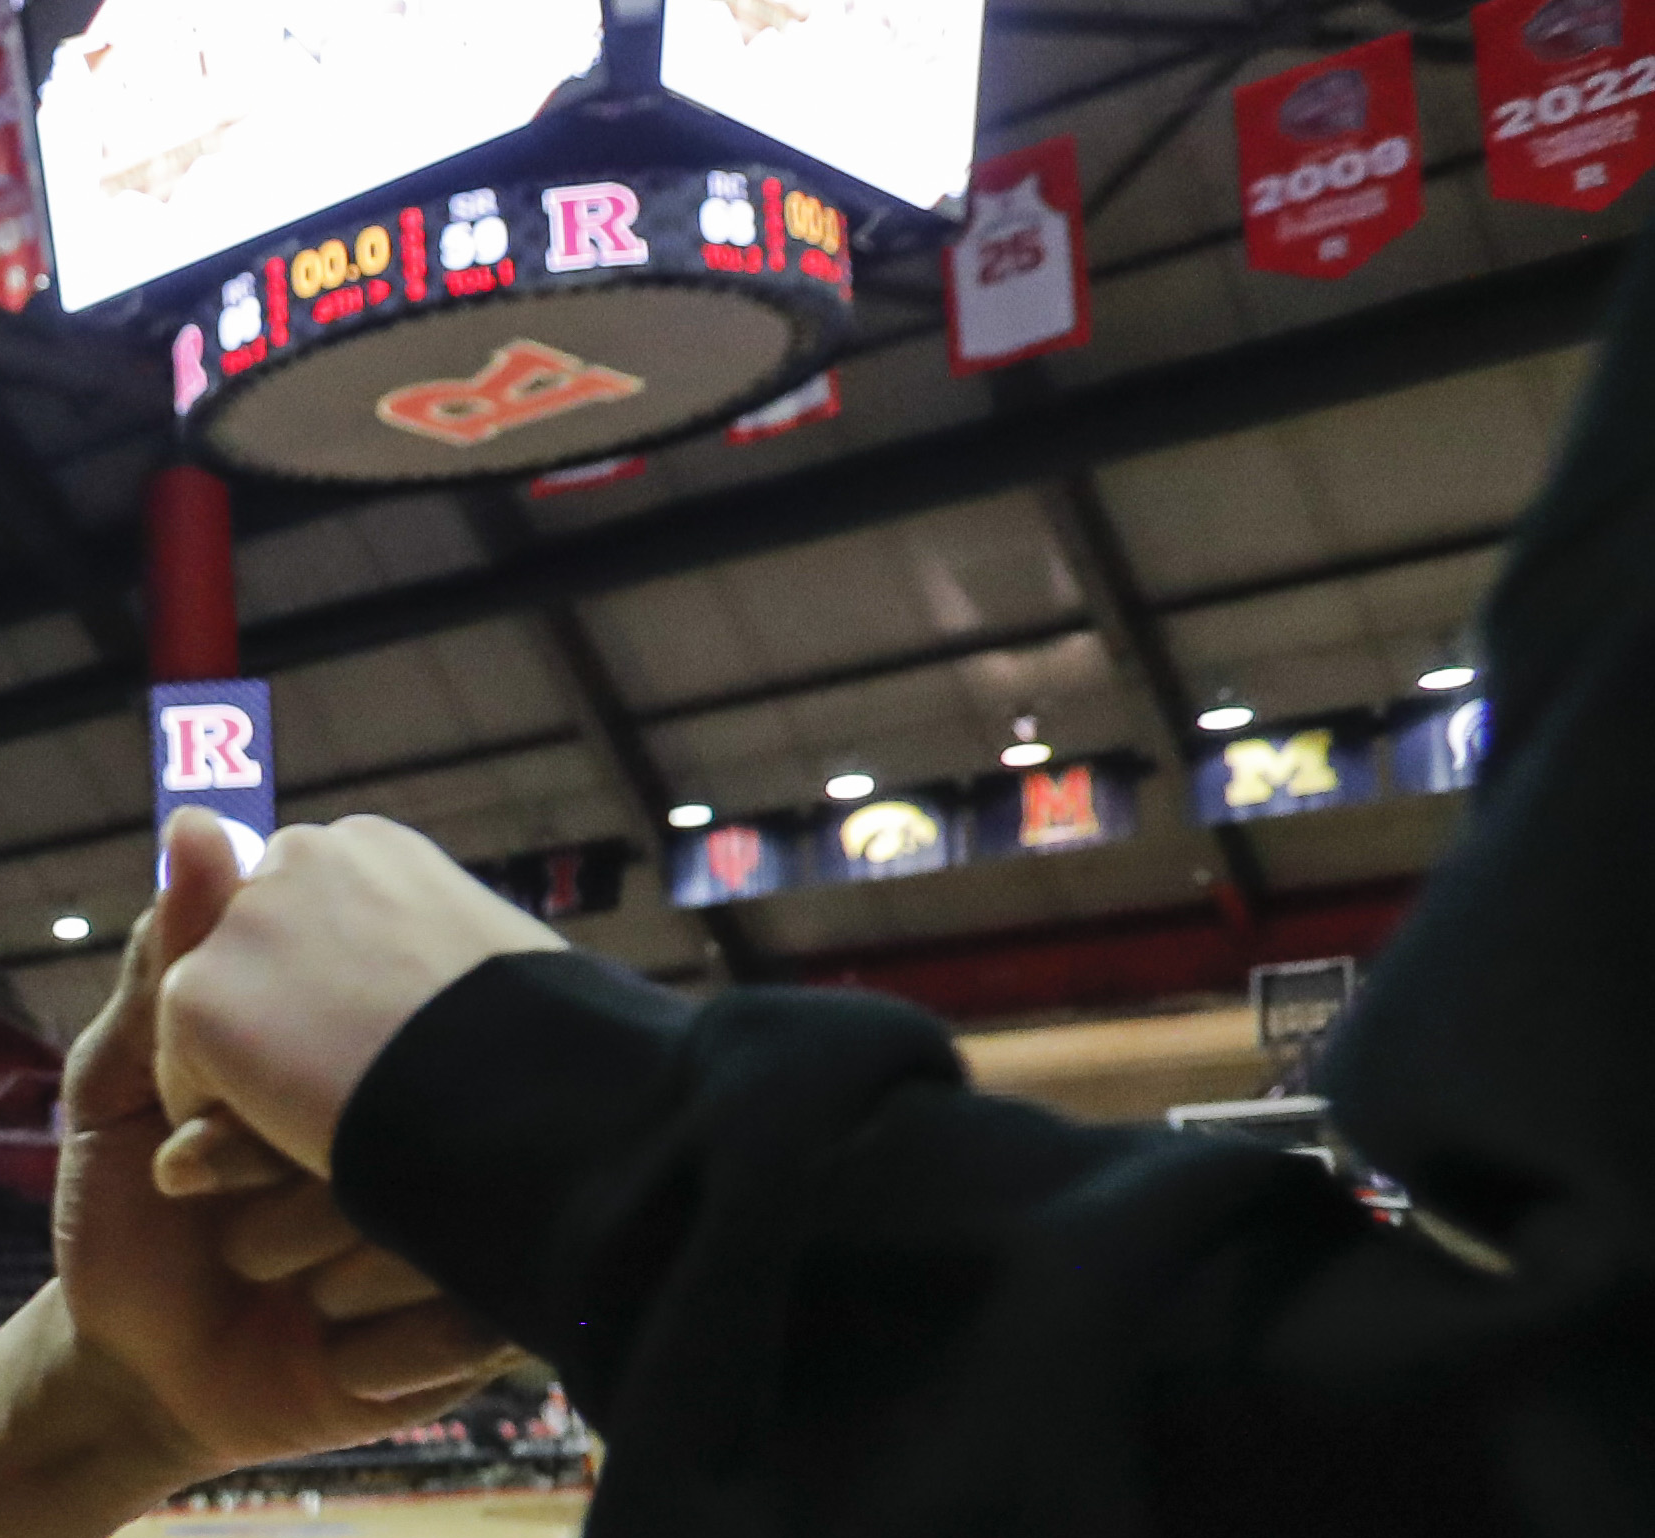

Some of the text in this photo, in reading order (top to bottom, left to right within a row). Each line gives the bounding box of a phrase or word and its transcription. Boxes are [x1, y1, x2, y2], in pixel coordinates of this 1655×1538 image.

[1492, 55, 1655, 141] 2022
[291, 225, 391, 299] 00.0
[541, 181, 649, 273] R
[160, 704, 263, 791] R
[1224, 729, 1338, 807] M
